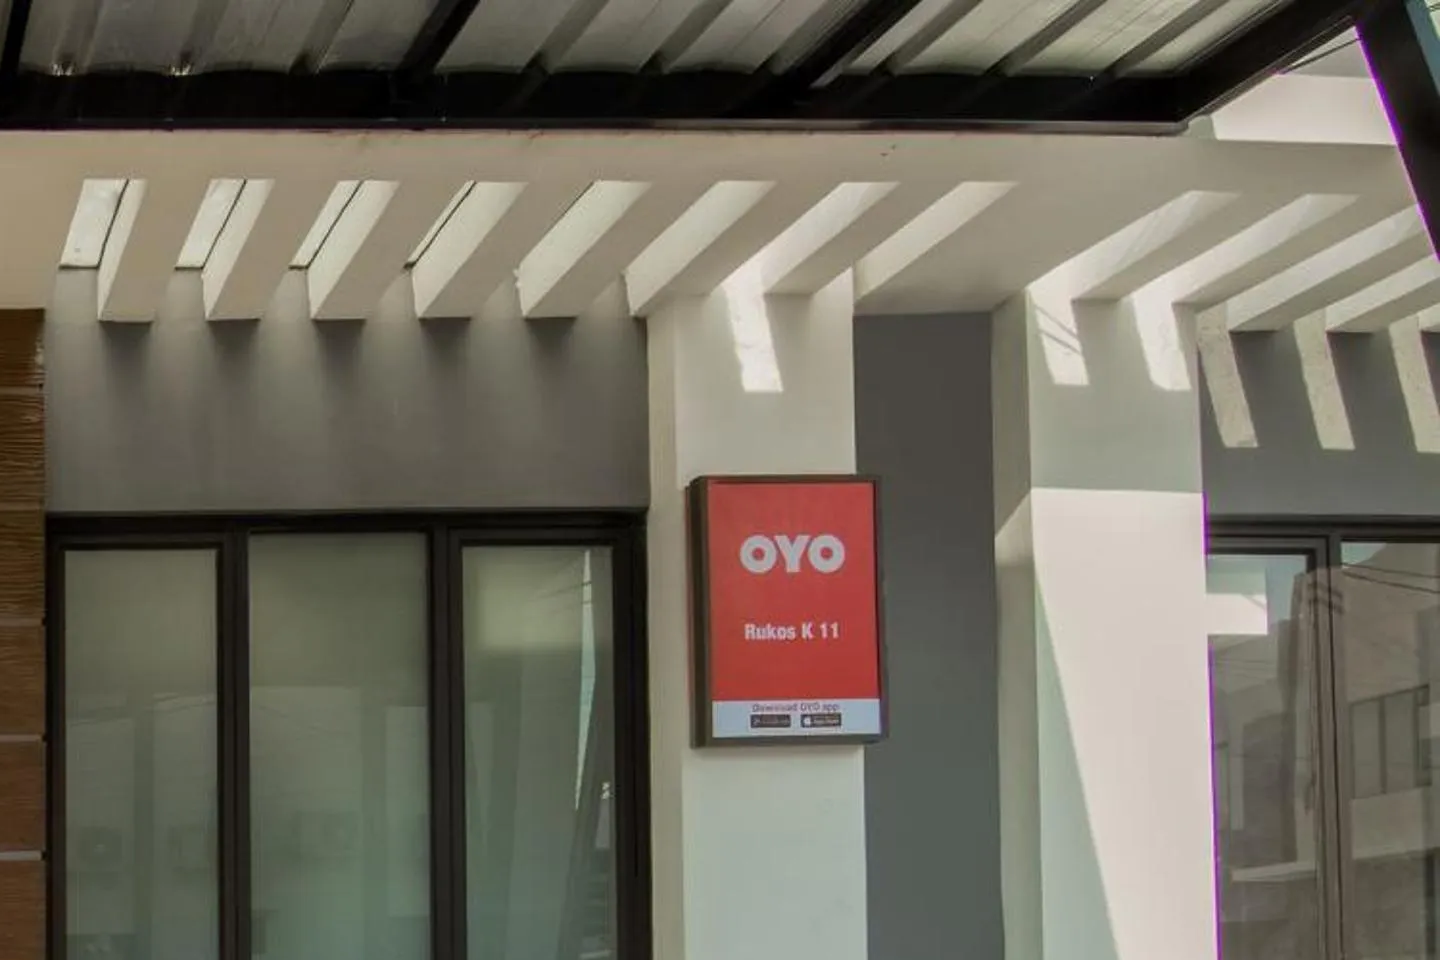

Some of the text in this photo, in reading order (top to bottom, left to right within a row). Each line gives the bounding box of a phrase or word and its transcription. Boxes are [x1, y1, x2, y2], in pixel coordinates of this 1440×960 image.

[740, 534, 845, 573] OYO
[744, 622, 839, 641] Rukos K 11
